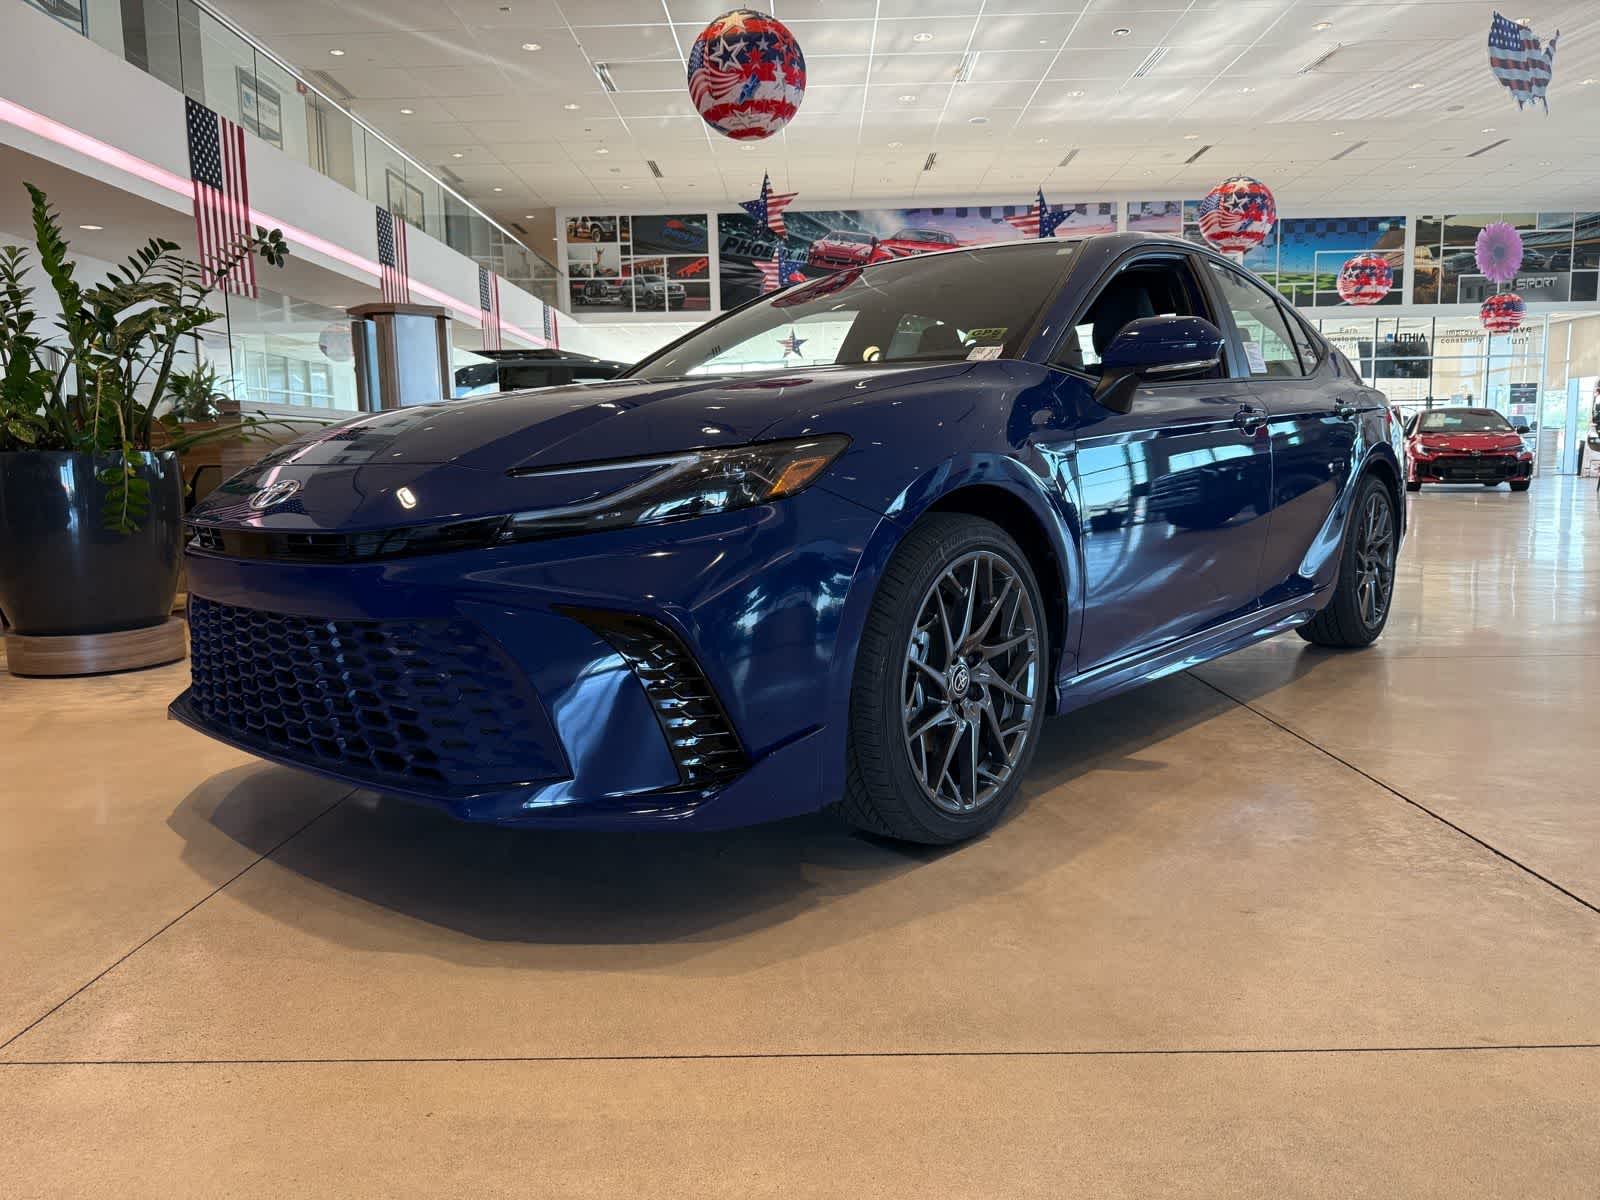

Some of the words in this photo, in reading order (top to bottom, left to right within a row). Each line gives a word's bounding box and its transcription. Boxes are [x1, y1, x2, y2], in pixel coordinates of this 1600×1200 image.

[1515, 276, 1559, 290] SPORT
[1512, 326, 1533, 334] ave
[1327, 335, 1370, 343] customers
[1393, 332, 1427, 344] LITHIA
[1440, 336, 1484, 345] constantly
